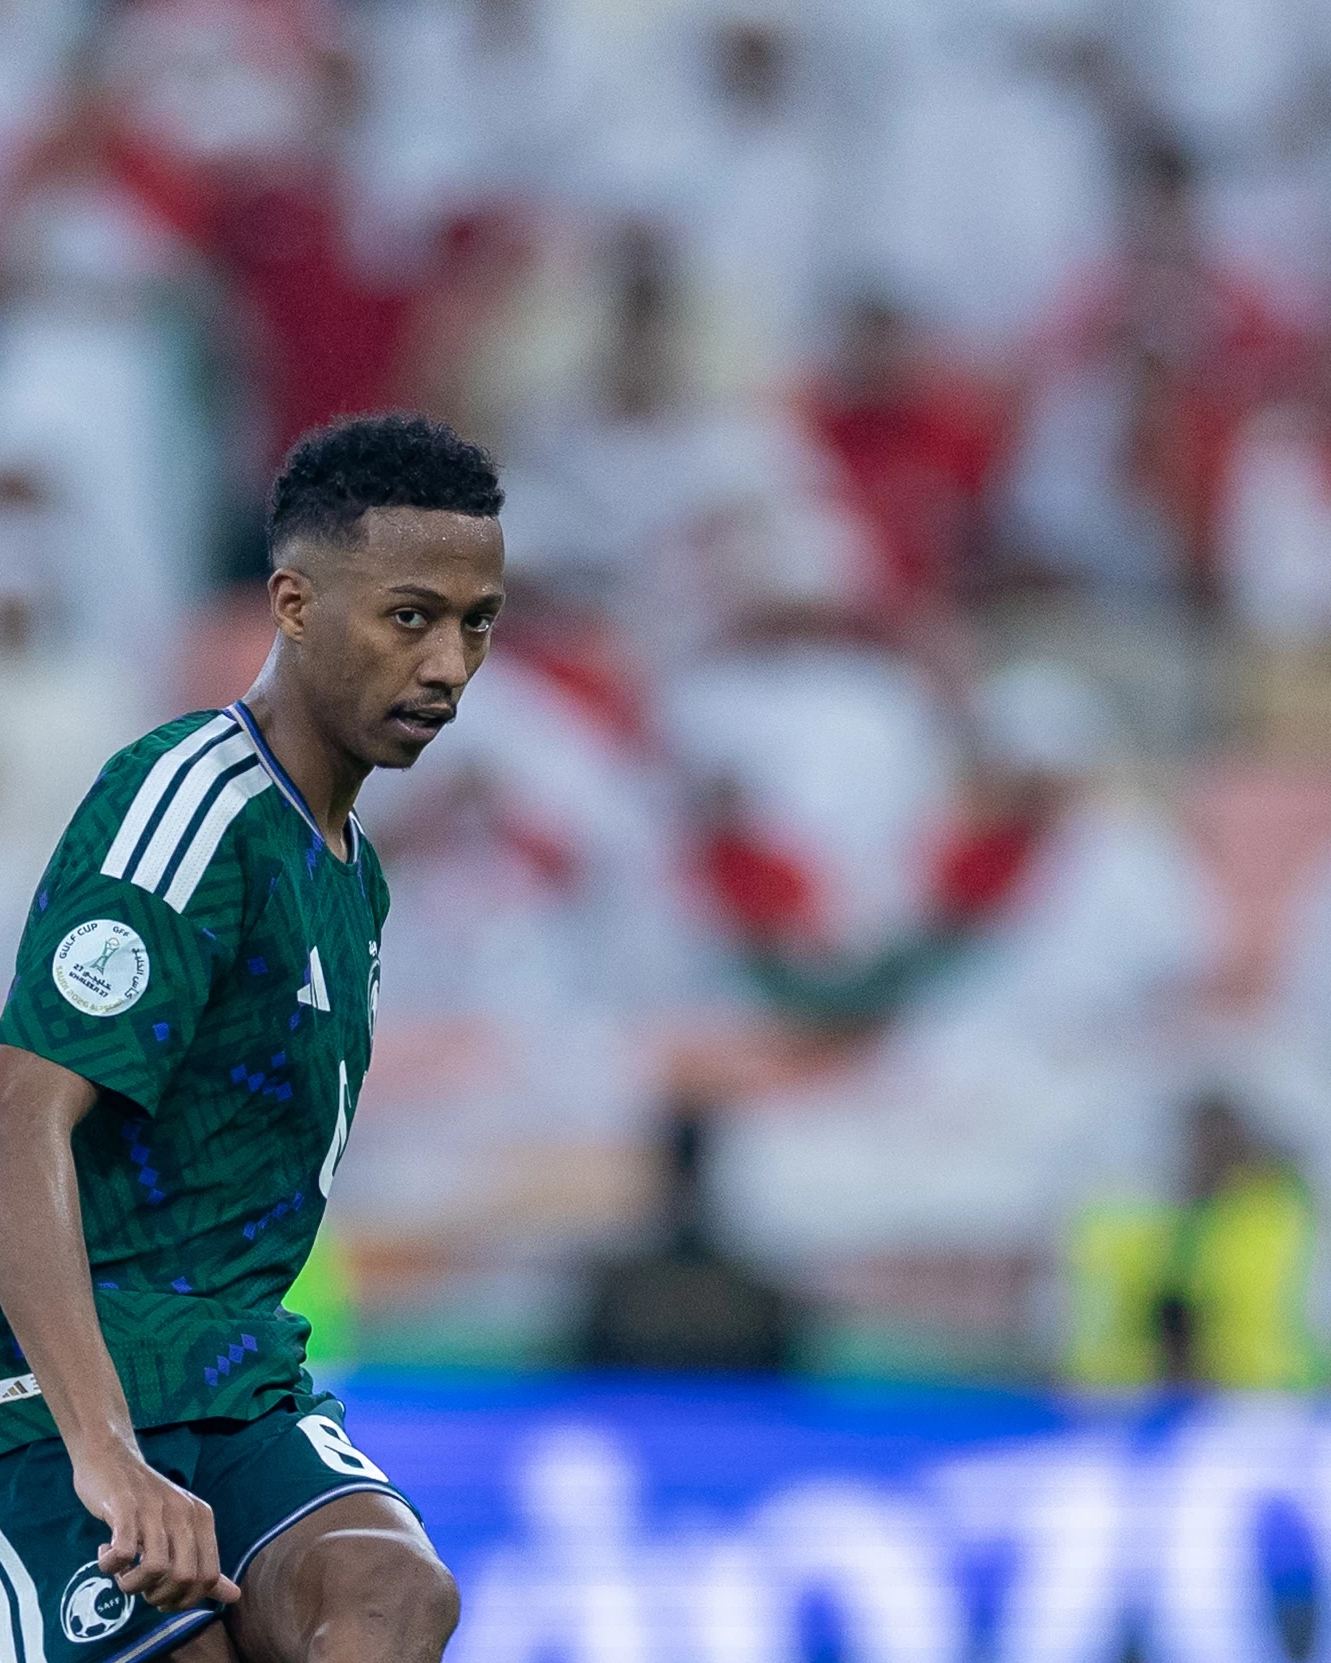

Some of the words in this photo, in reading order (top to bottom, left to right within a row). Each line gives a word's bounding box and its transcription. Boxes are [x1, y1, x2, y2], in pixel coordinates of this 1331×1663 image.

[112, 926, 130, 938] GFF
[58, 933, 76, 960] GULF
[77, 922, 98, 937] CUP
[99, 989, 109, 998] 27
[97, 1597, 120, 1612] SAFF
